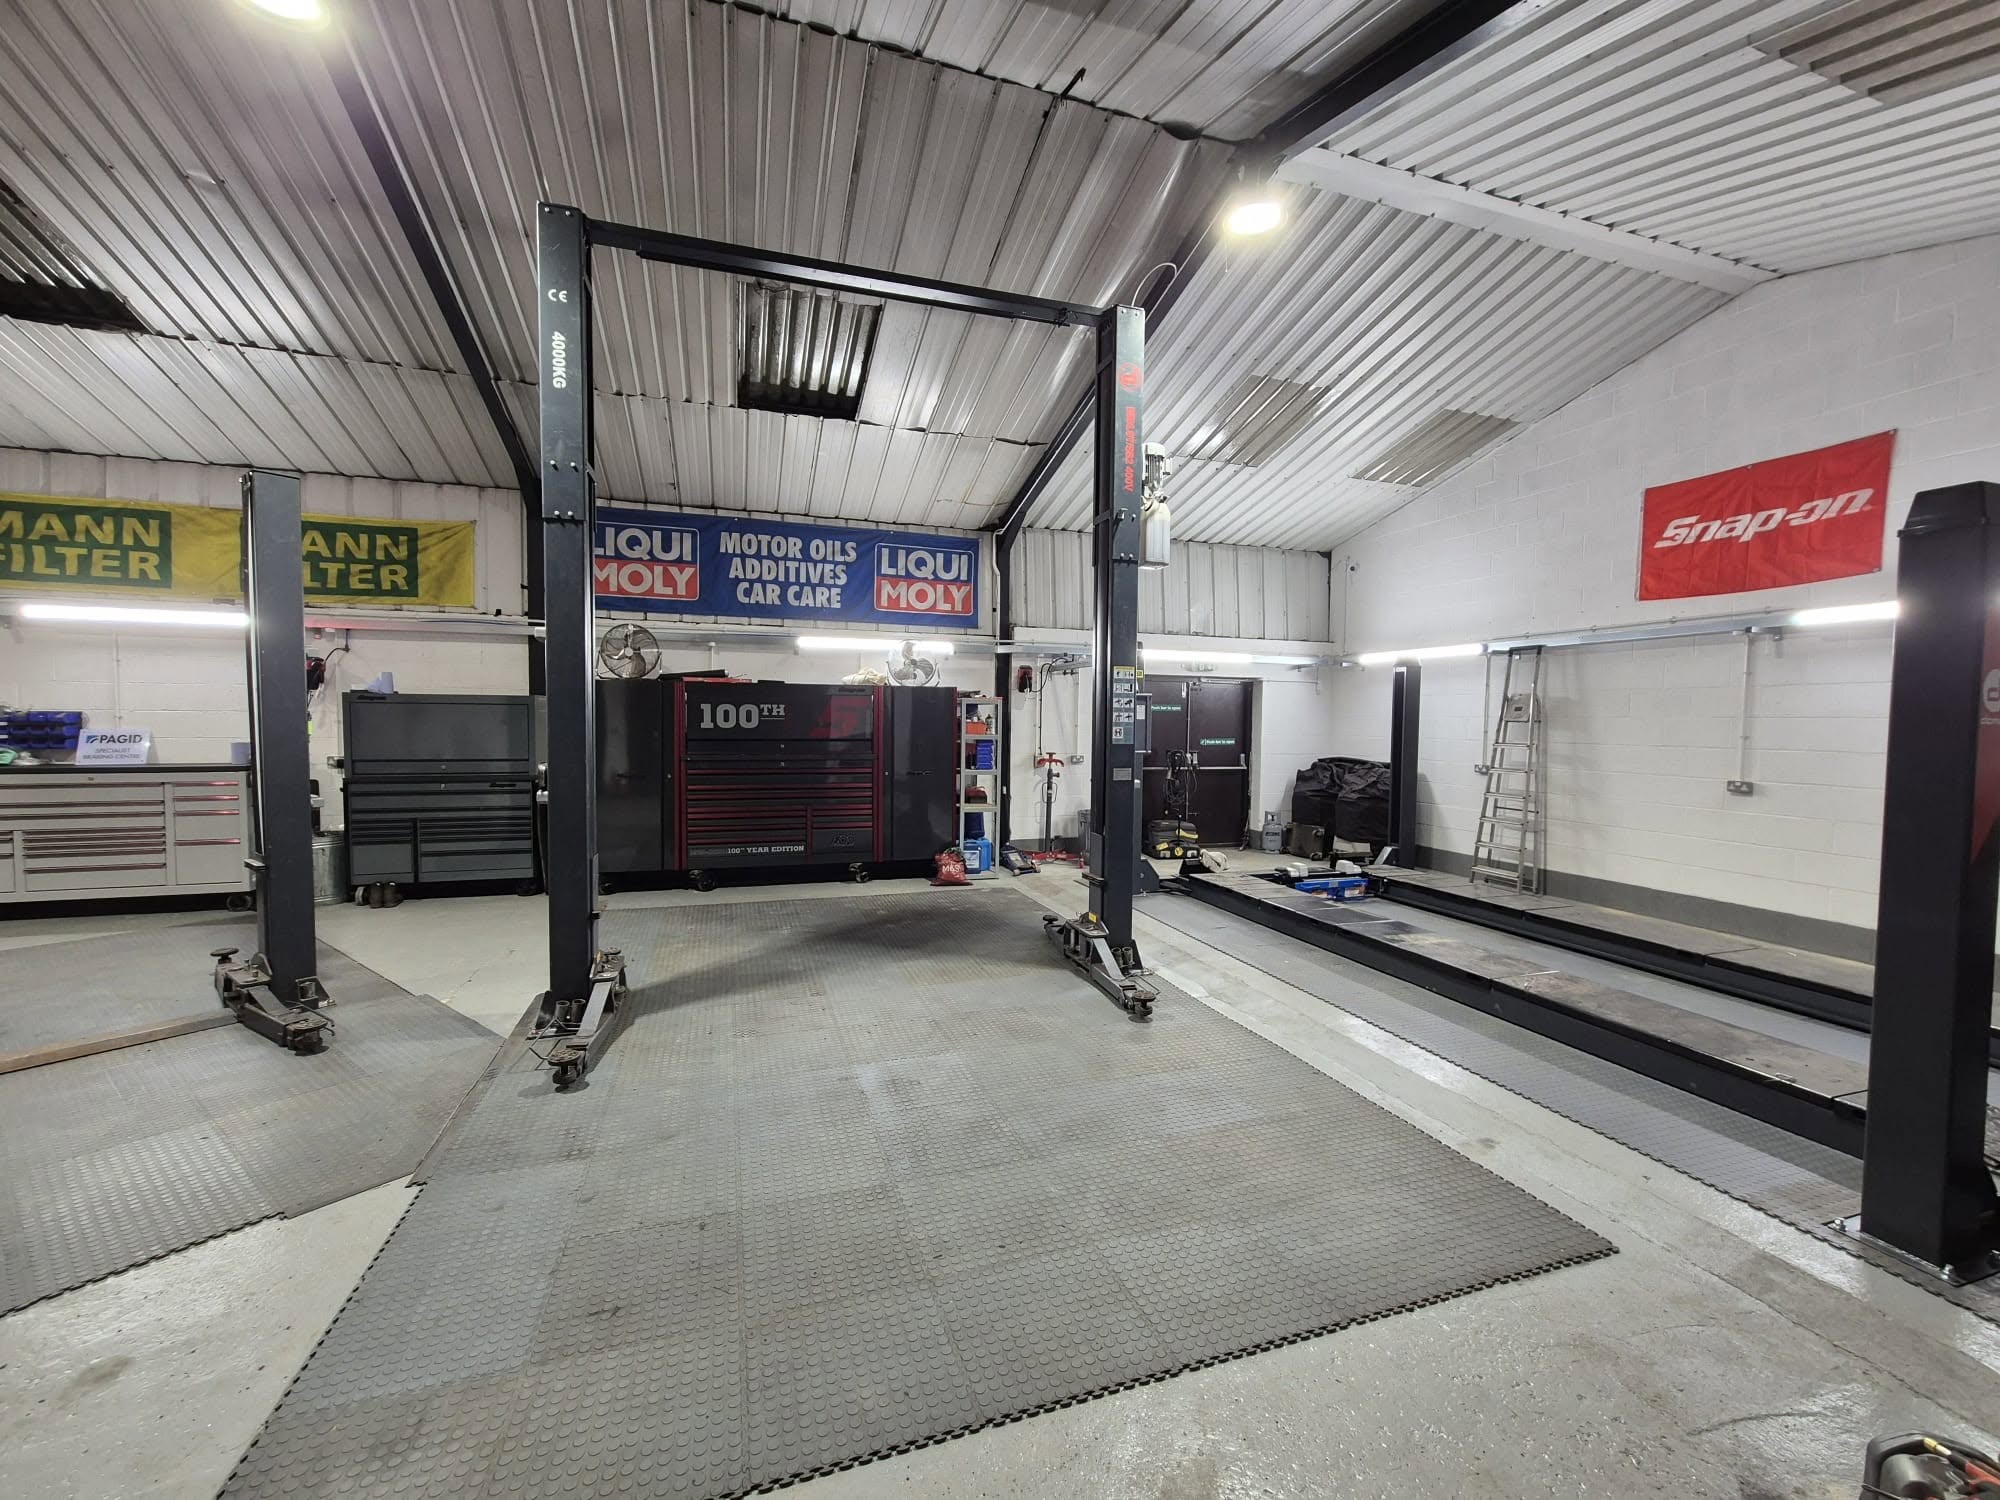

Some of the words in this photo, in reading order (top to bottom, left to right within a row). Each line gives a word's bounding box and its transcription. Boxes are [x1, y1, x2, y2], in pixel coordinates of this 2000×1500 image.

[551, 331, 567, 389] 4000KG
[1654, 487, 1875, 549] Snap-on
[302, 530, 408, 560] ANN
[720, 531, 803, 559] MOTOR
[810, 537, 857, 563] OILS
[0, 543, 161, 580] ILTER
[303, 561, 409, 590] LTER
[729, 556, 848, 586] ADDITIVES
[881, 549, 969, 581] LIQUI
[593, 563, 696, 596] MOLY
[736, 581, 784, 606] CAR
[787, 584, 842, 609] CARE
[881, 581, 972, 611] MOLY
[700, 703, 786, 729] 100TH
[100, 734, 143, 744] PAGID
[746, 846, 769, 854] YEAR
[771, 845, 805, 853] EDITION
